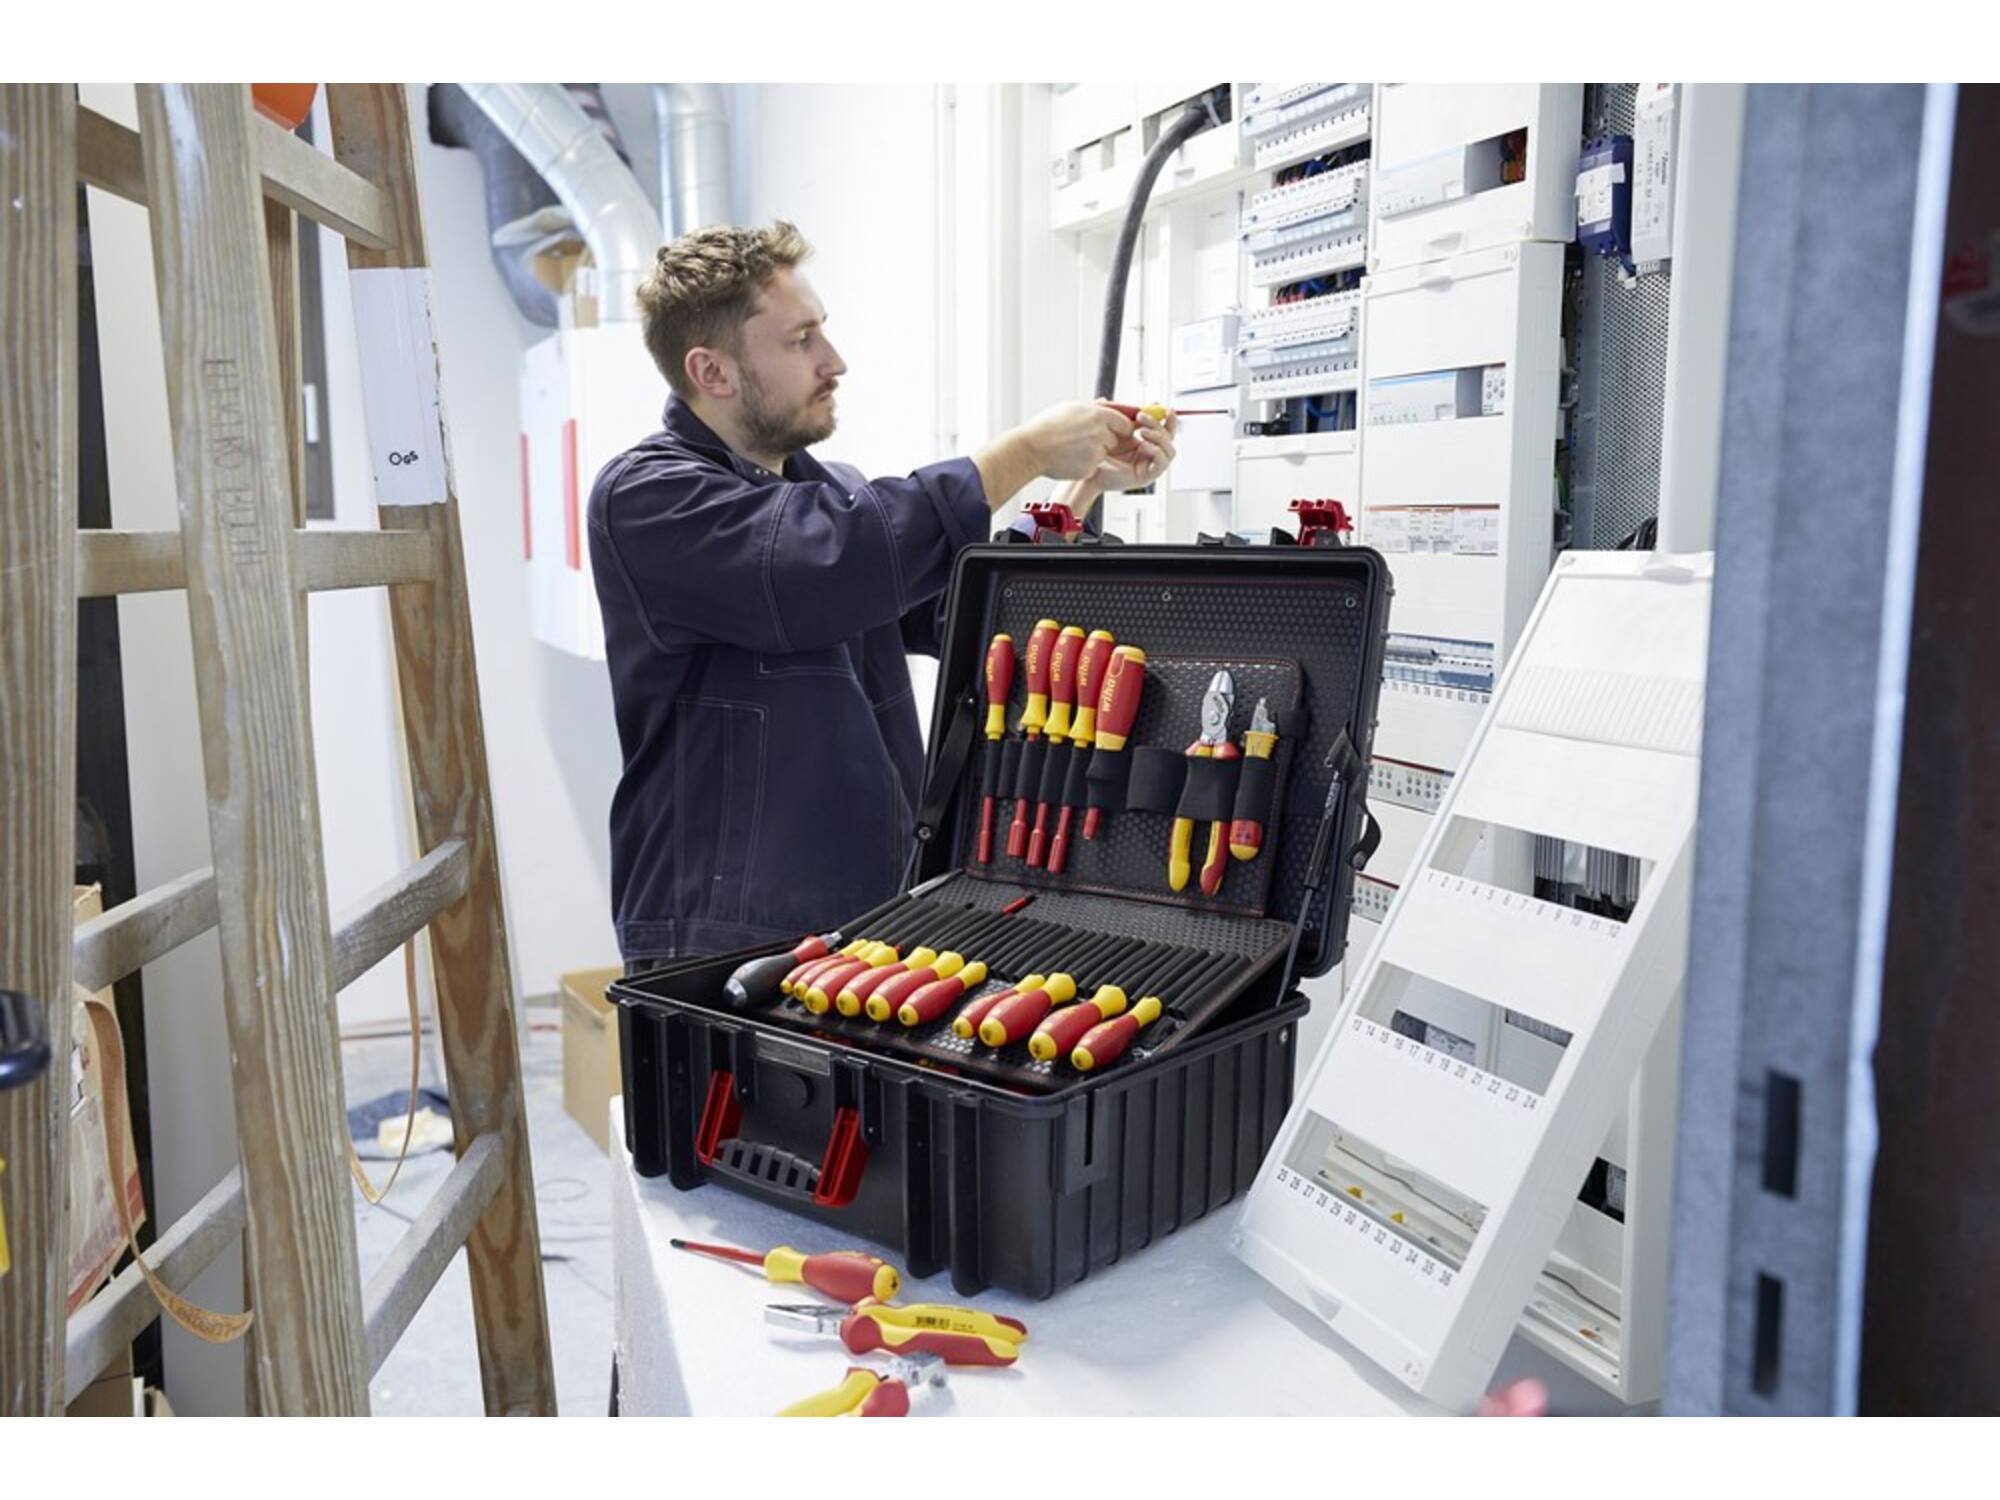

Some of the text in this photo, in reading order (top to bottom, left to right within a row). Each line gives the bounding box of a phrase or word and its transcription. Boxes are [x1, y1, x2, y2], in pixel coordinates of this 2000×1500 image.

[1077, 655, 1090, 686] wiha
[1101, 677, 1117, 712] wiha
[1351, 1019, 1538, 1109] 13 14 15 16 17 18 19 20 21 22 23 24
[1276, 1168, 1453, 1286] 25 26 27 28 29 30 31 32 33 34 35 36
